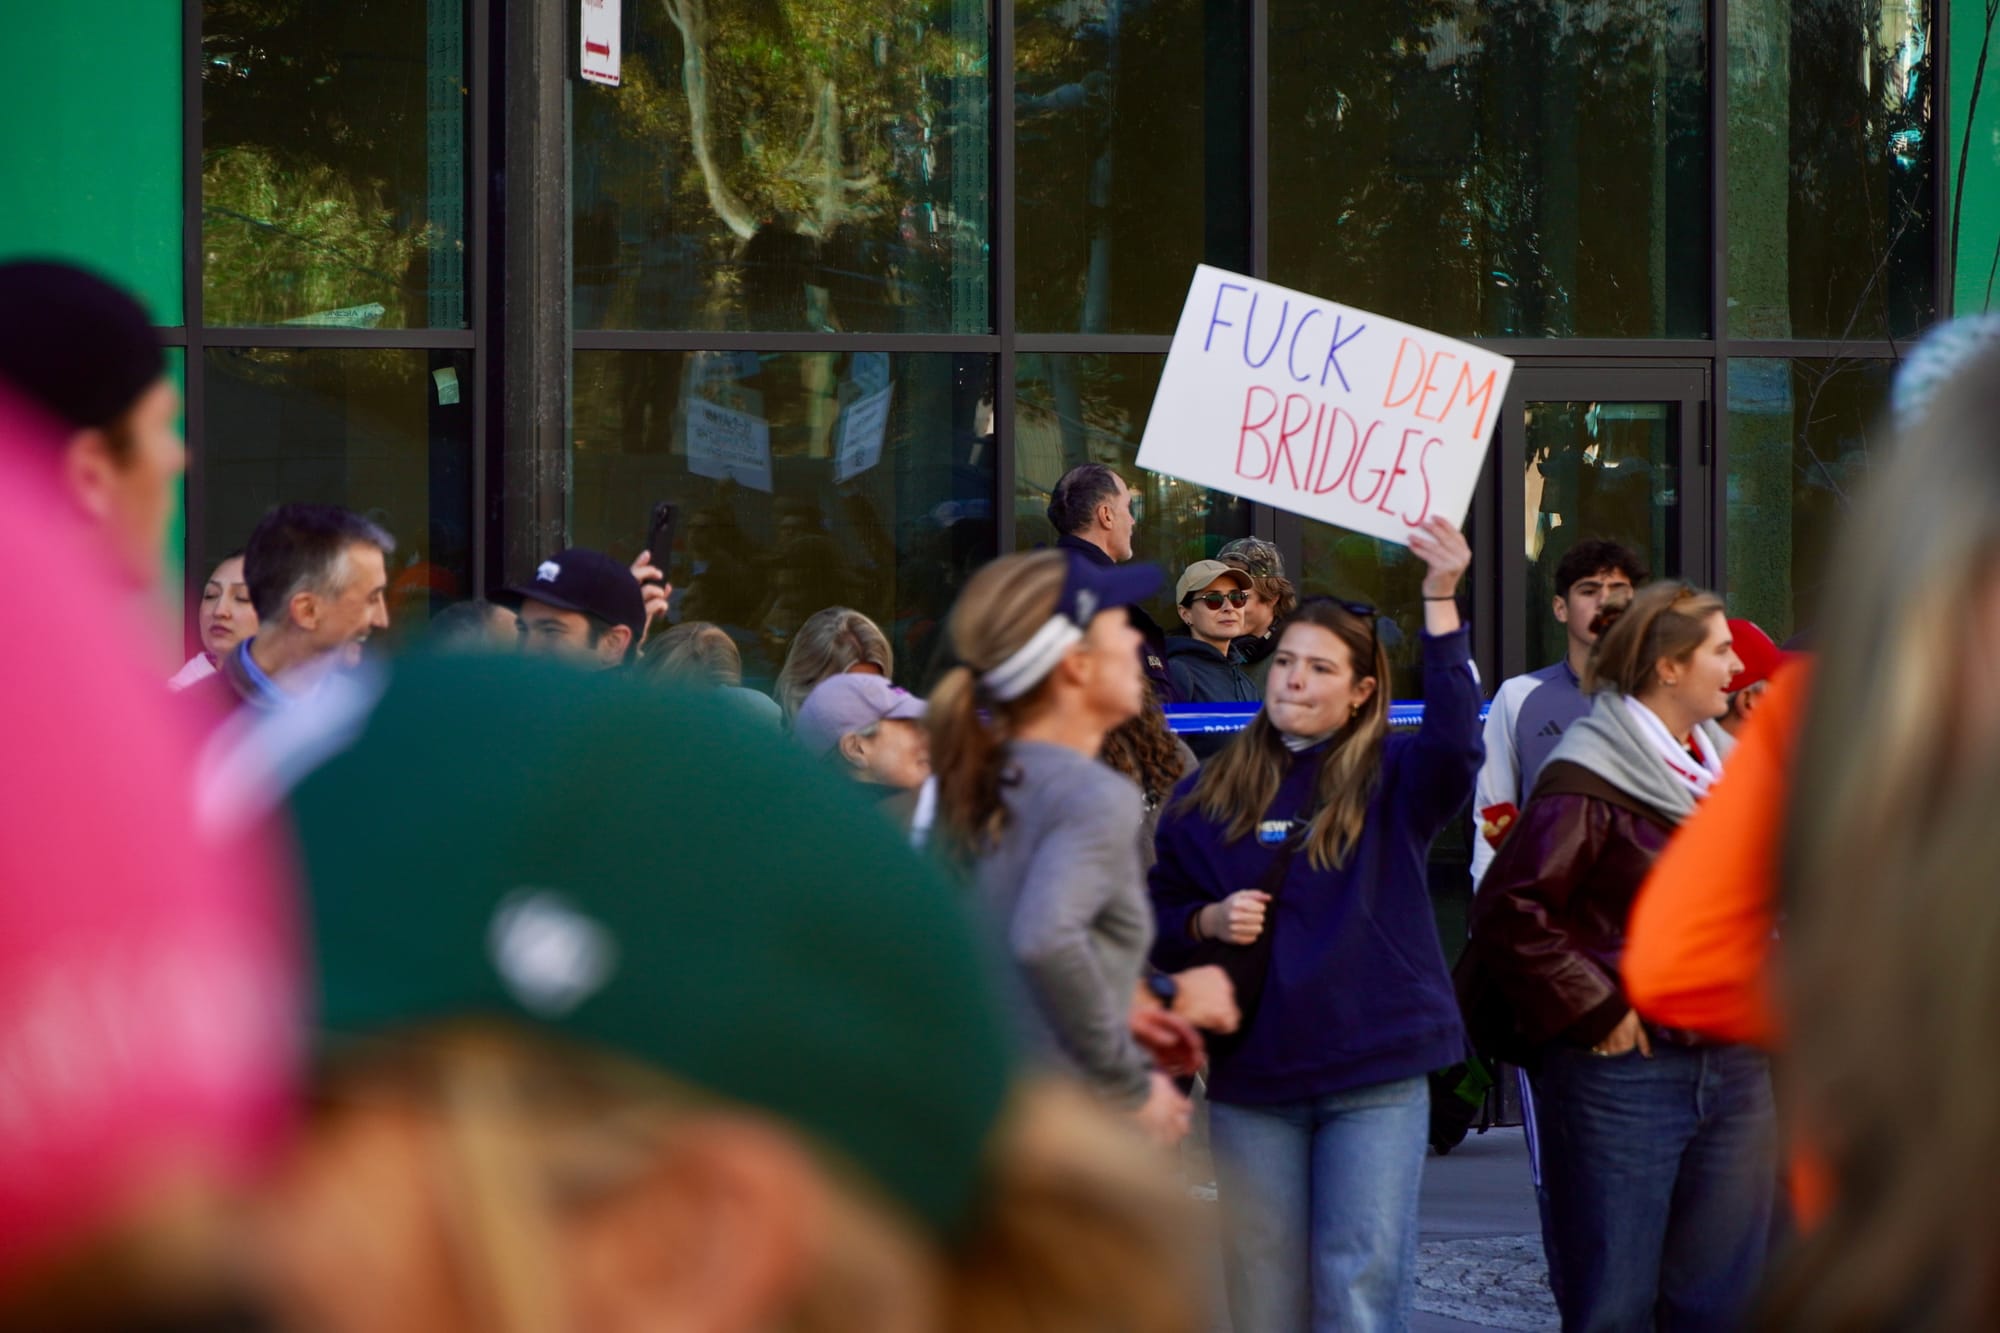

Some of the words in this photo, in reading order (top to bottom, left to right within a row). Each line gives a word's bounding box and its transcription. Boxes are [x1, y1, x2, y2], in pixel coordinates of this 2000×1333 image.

[1203, 282, 1366, 393] FUCK
[1382, 336, 1497, 440] DEM
[1234, 385, 1444, 528] BRIDGES
